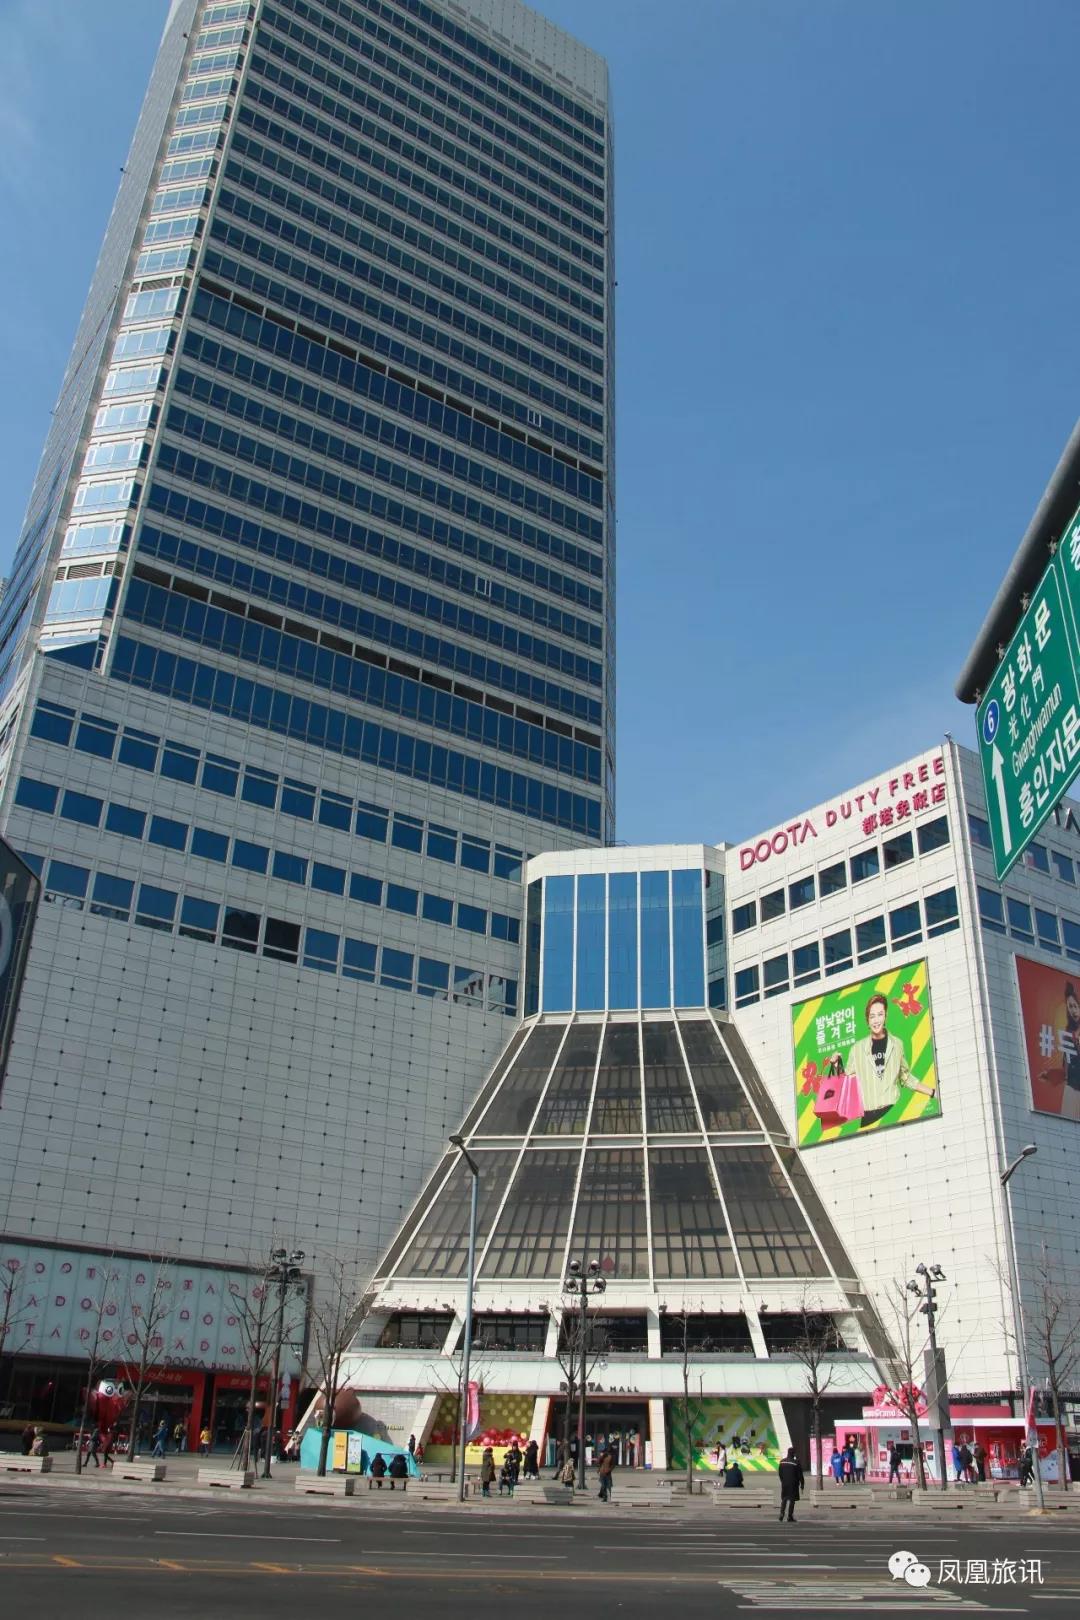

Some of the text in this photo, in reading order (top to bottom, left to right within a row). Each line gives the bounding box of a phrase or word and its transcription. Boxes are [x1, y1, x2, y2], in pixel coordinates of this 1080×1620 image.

[1000, 597, 1051, 712] 광화문
[986, 711, 996, 733] 6
[1007, 663, 1045, 747] 光化門
[1012, 682, 1063, 778] Gwanghwamun
[1018, 703, 1080, 828] 흥인지문
[739, 756, 945, 871] DOOTA DUTY FREE
[815, 1005, 855, 1030] 밤낮없이
[609, 1385, 640, 1393] MALL
